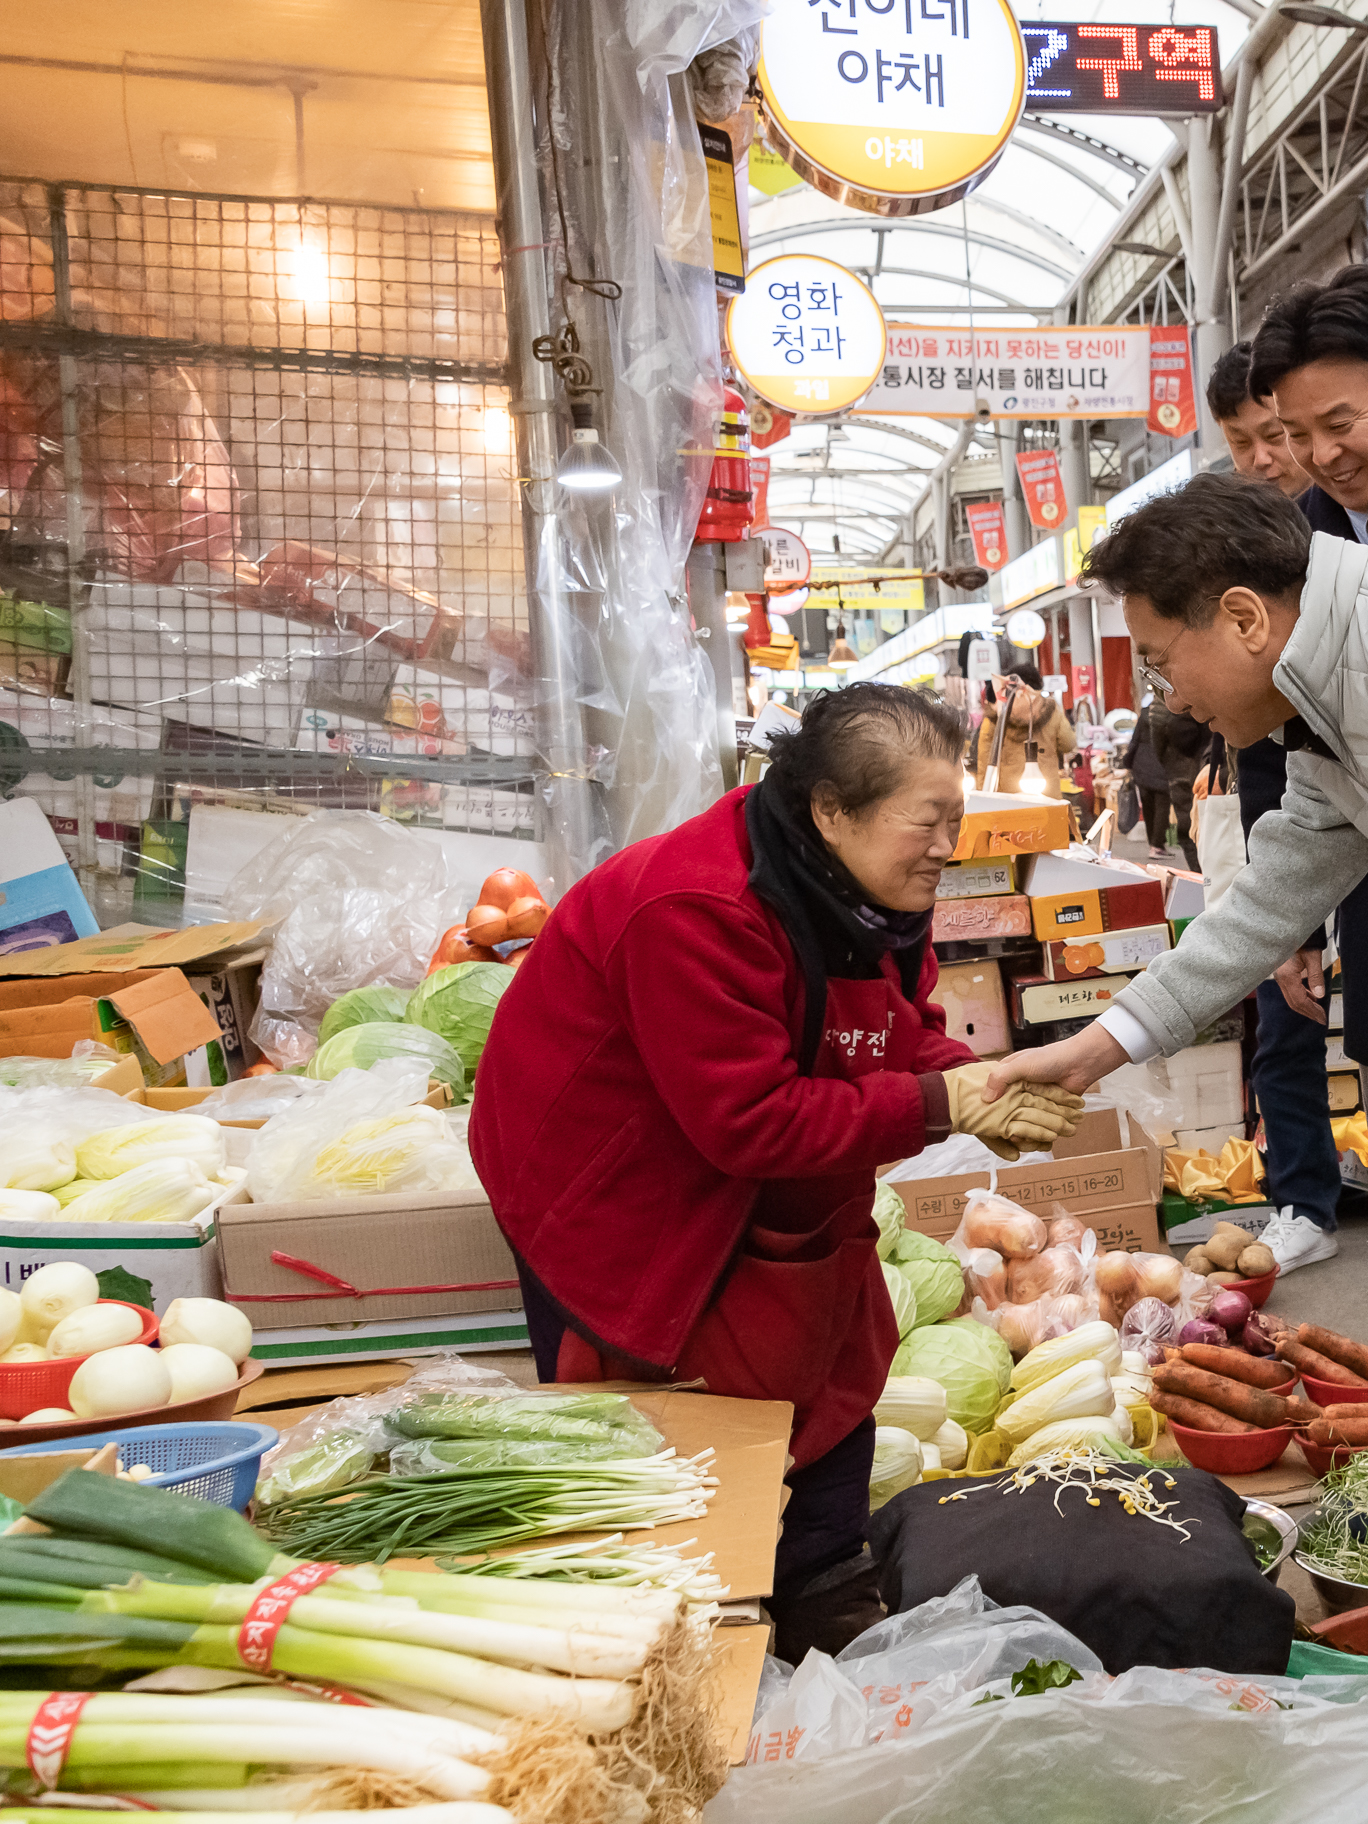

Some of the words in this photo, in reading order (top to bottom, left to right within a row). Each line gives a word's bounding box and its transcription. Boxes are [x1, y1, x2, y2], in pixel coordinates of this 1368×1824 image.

[837, 48, 945, 108] 야채
[864, 136, 924, 171] 야채
[768, 281, 843, 320] 영화
[772, 325, 846, 365] 청과
[945, 338, 1000, 359] 지키지
[1006, 339, 1060, 360] 못하는
[1066, 339, 1126, 360] 당신이!
[875, 366, 947, 390] 통시장
[953, 367, 1017, 391] 질서를
[1023, 367, 1109, 391] 해칩니다
[1039, 1182, 1076, 1198] 13-15
[1083, 1174, 1120, 1190] 16-20
[919, 1200, 942, 1214] 수량
[1097, 1223, 1135, 1244] Jeju
